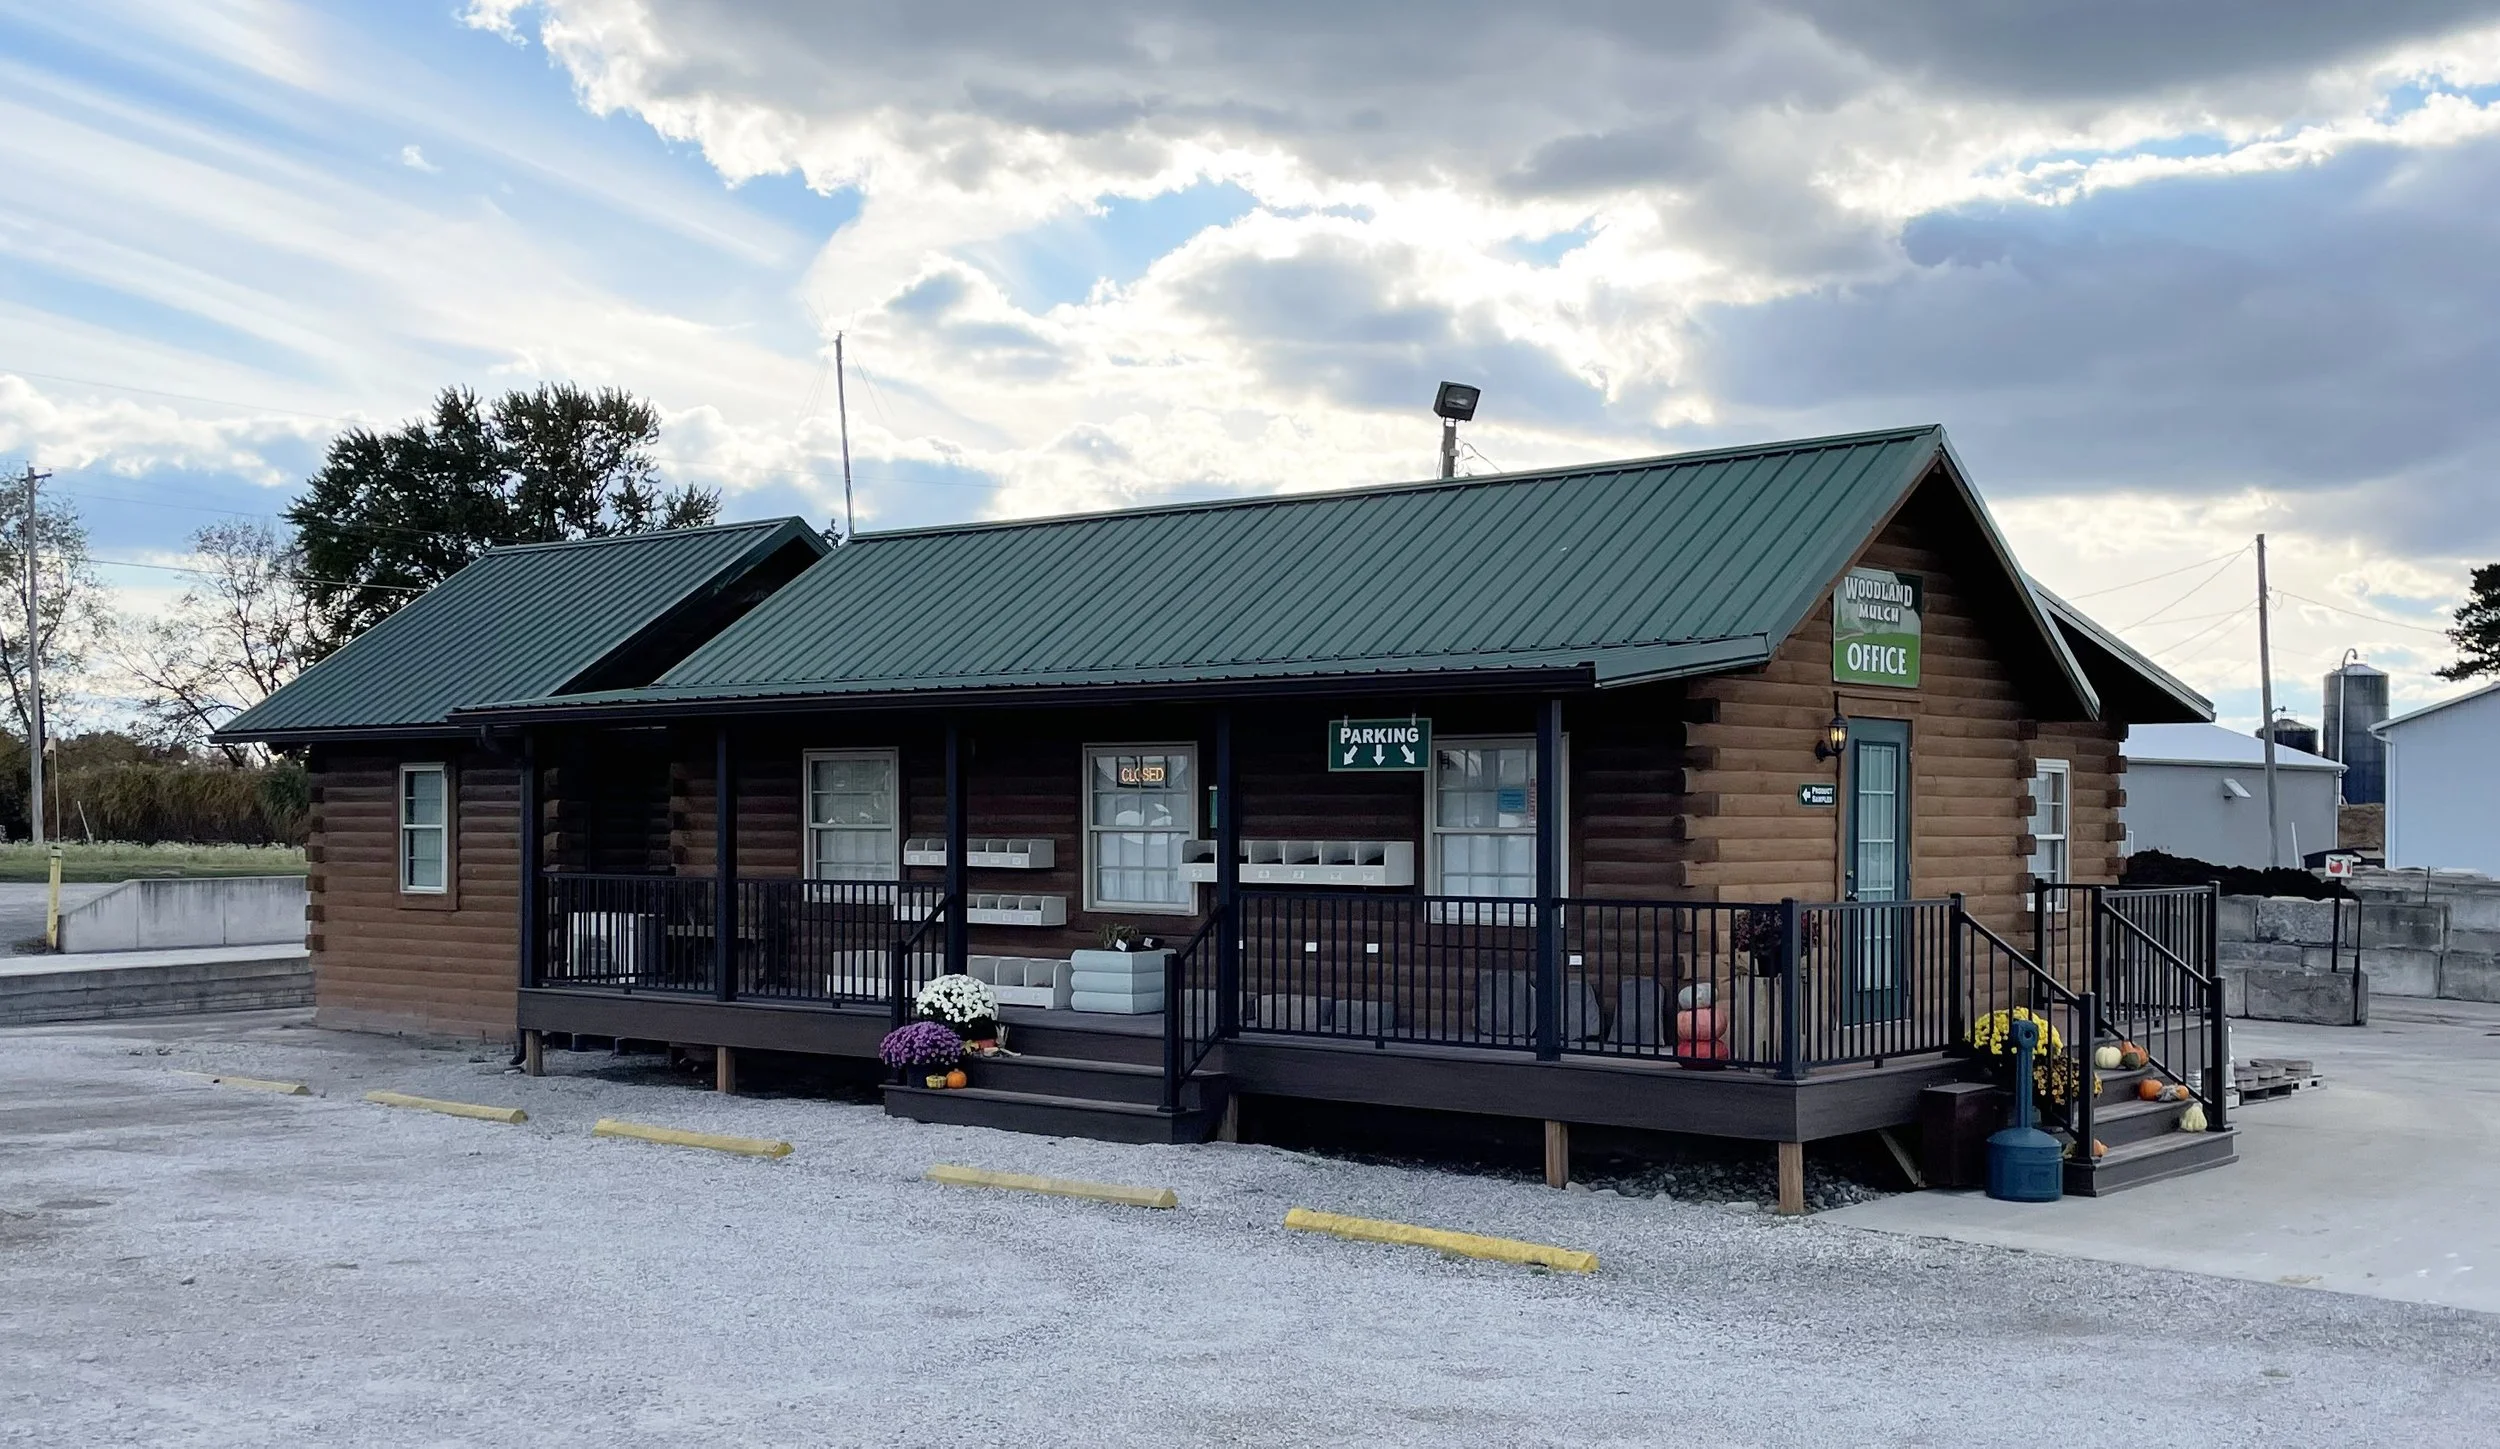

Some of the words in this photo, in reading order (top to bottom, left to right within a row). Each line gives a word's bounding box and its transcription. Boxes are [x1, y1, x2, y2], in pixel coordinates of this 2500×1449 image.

[1844, 576, 1913, 607] WOODLAND
[1859, 603, 1899, 622] MULCH
[1847, 642, 1907, 675] OFFICE
[1340, 727, 1419, 744] PARKING
[1121, 767, 1164, 782] CLOSED
